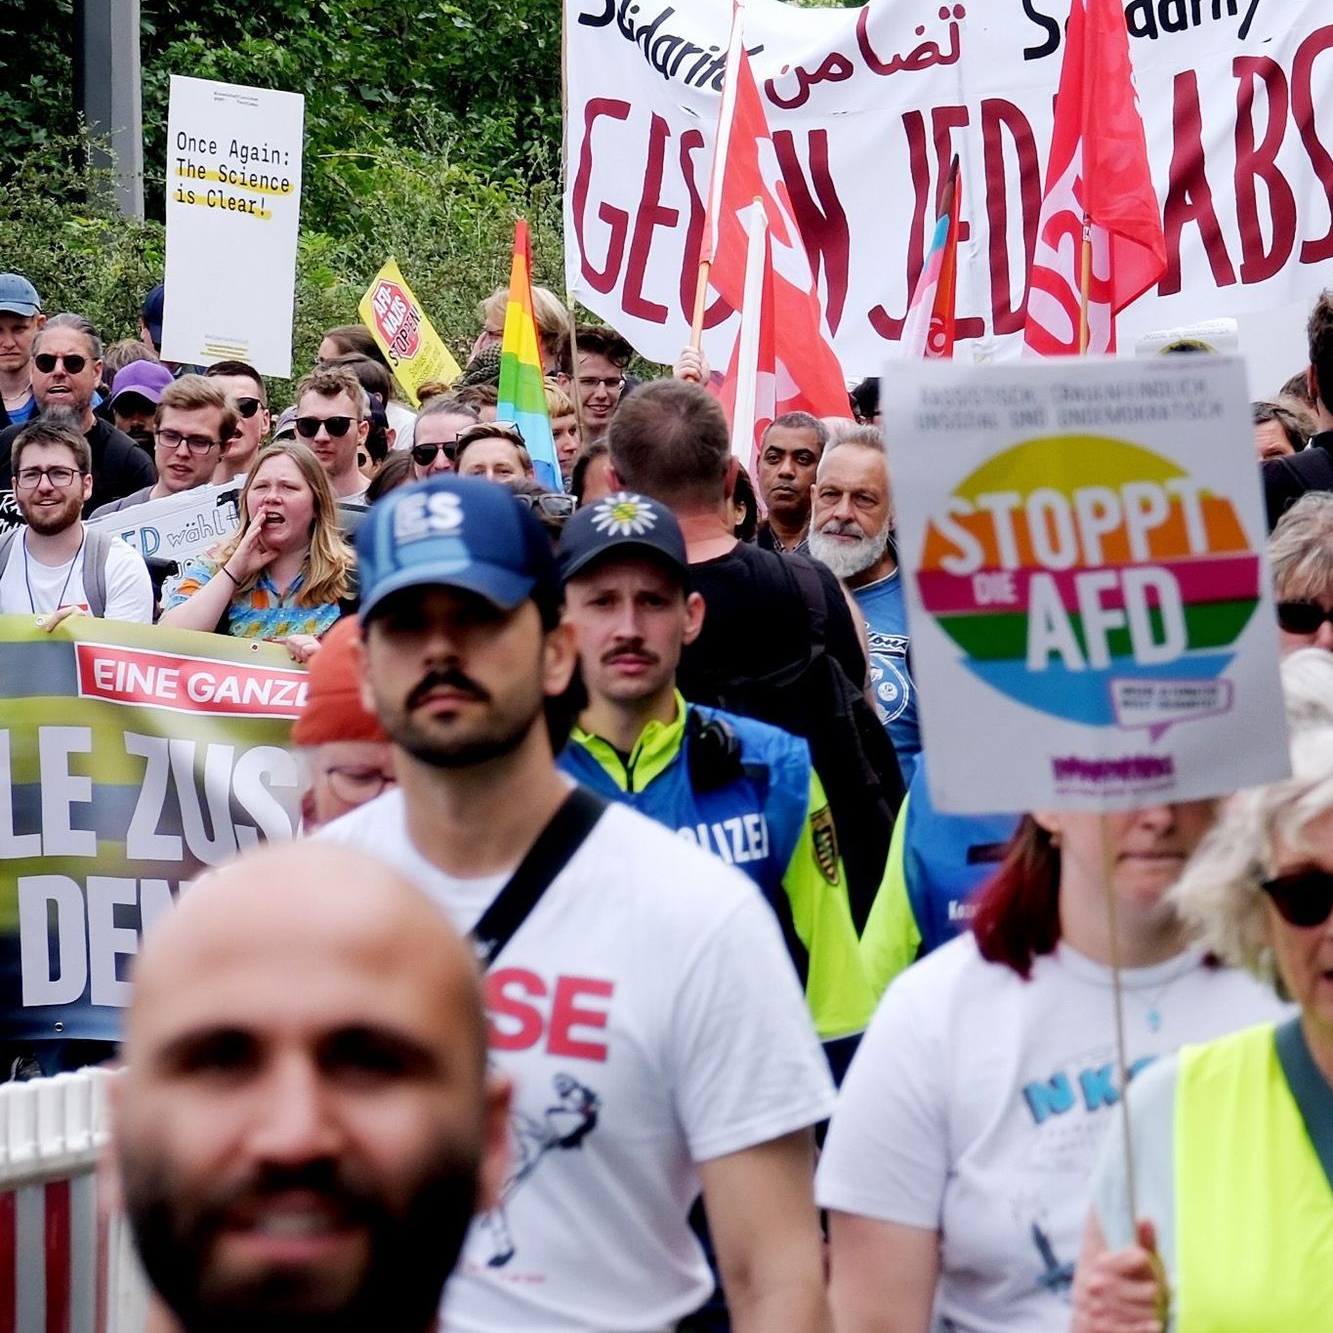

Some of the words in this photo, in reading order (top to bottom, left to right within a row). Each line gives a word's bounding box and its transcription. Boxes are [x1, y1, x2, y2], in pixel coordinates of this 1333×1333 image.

[765, 5, 966, 110] تضامن
[177, 131, 217, 155] Once
[229, 139, 290, 166] Again:
[177, 158, 206, 180] The
[218, 164, 290, 194] Science
[177, 184, 195, 205] is
[207, 189, 266, 216] Clear!
[867, 94, 1062, 341] JED
[930, 476, 1213, 576] STOPPT
[972, 570, 1018, 604] DIE
[1026, 566, 1188, 672] AFD
[93, 658, 181, 699] EINE
